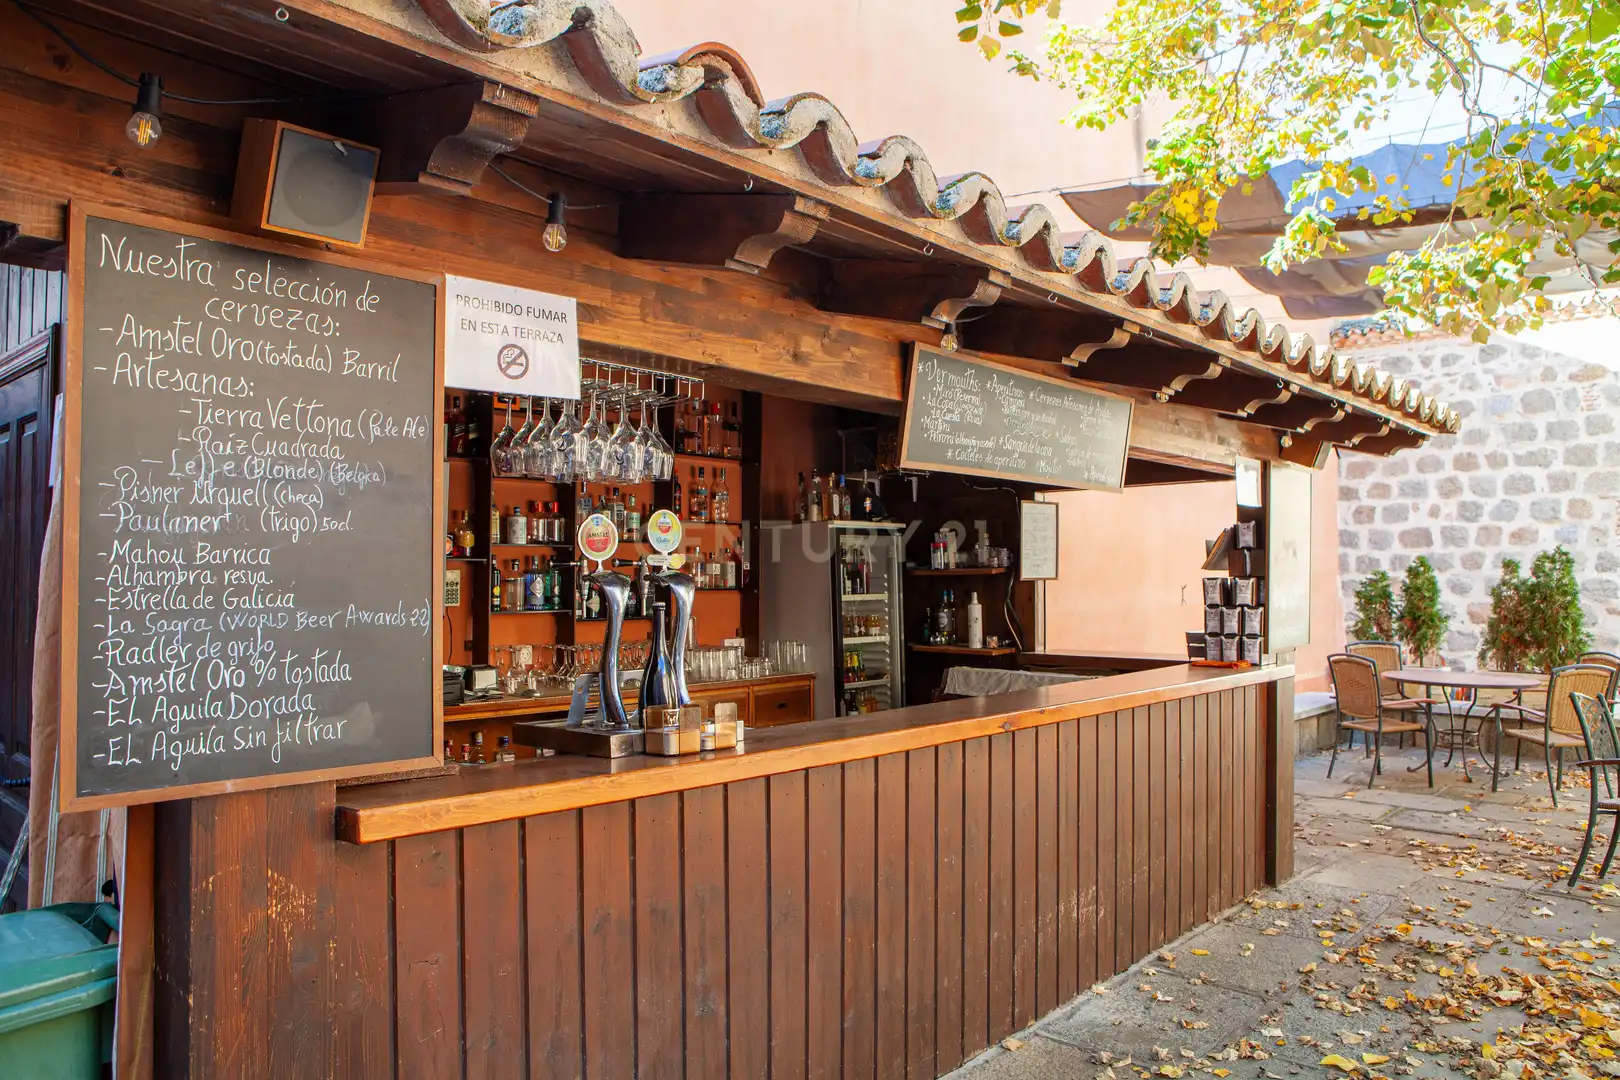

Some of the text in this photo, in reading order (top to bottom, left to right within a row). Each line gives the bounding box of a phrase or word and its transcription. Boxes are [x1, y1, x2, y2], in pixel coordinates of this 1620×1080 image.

[100, 233, 380, 312] Nuestra selección de
[205, 298, 340, 337] cervezas:
[456, 294, 568, 324] PROHIBIDO FUMAR
[461, 318, 564, 344] EN ESTA TERRAZA
[342, 348, 400, 382] Barril
[267, 396, 354, 438] Vettona
[358, 409, 398, 445] (Pale
[402, 415, 429, 443] Ale)
[923, 415, 951, 432] Martini
[252, 423, 345, 459] Cuadrada
[274, 481, 323, 509] (checa)
[261, 504, 317, 543] (trigo)
[193, 541, 271, 564] Barrica
[192, 585, 215, 609] de
[223, 583, 294, 609] Galicia
[142, 612, 212, 646] Sagra
[294, 610, 342, 632] Beer
[345, 600, 406, 628] Awards
[197, 632, 222, 660] de
[228, 625, 274, 666] grifo
[207, 659, 245, 690] Oro
[280, 648, 352, 684] tostada
[152, 690, 223, 734] Aguila
[227, 680, 317, 720] Dorada
[152, 725, 226, 770] Aguila
[234, 726, 266, 750] Sin
[271, 712, 348, 763] filtrar
